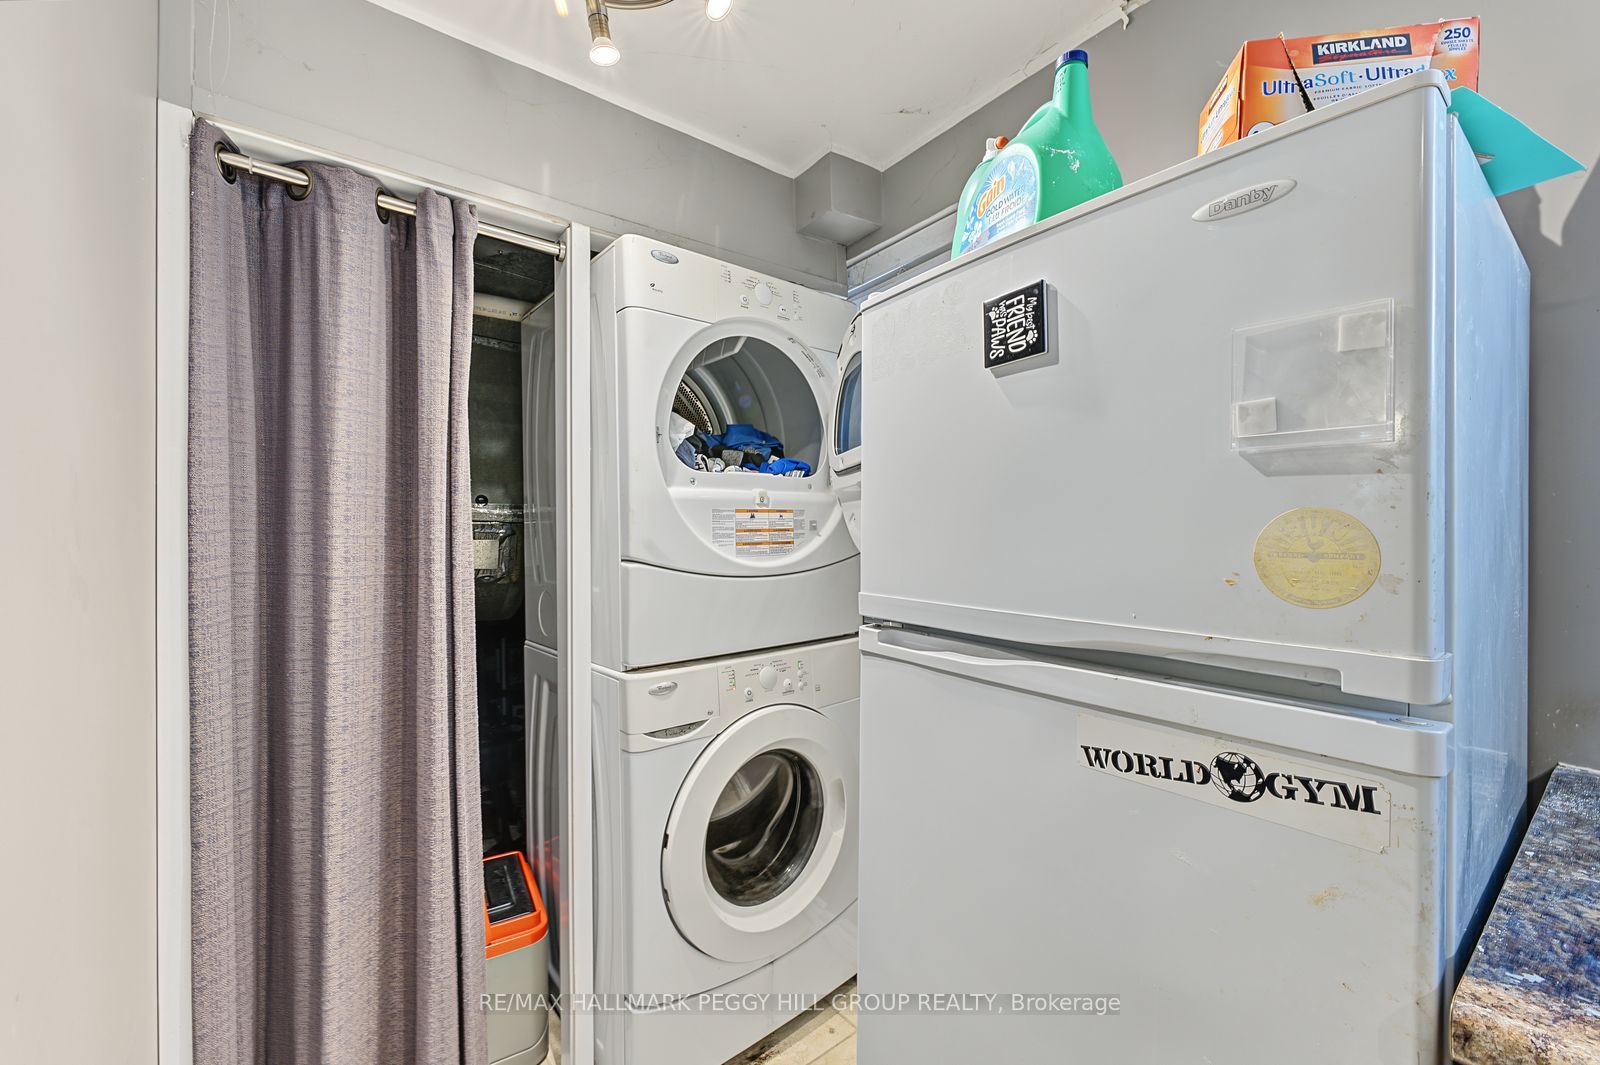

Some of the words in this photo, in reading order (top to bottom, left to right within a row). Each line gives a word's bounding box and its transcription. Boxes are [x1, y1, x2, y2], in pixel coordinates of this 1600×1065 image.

[1317, 36, 1407, 56] KIRKLAND
[1443, 26, 1471, 41] 250
[1262, 70, 1357, 96] UltraSoft
[977, 175, 1006, 218] Gain
[986, 199, 1004, 218] COLD
[1208, 184, 1279, 217] Danby
[998, 299, 1008, 318] has
[1025, 296, 1038, 312] My
[1005, 294, 1027, 353] FRIEND
[989, 317, 1006, 360] PAWS
[1080, 745, 1211, 785] WORLD
[1265, 772, 1381, 815] GYM
